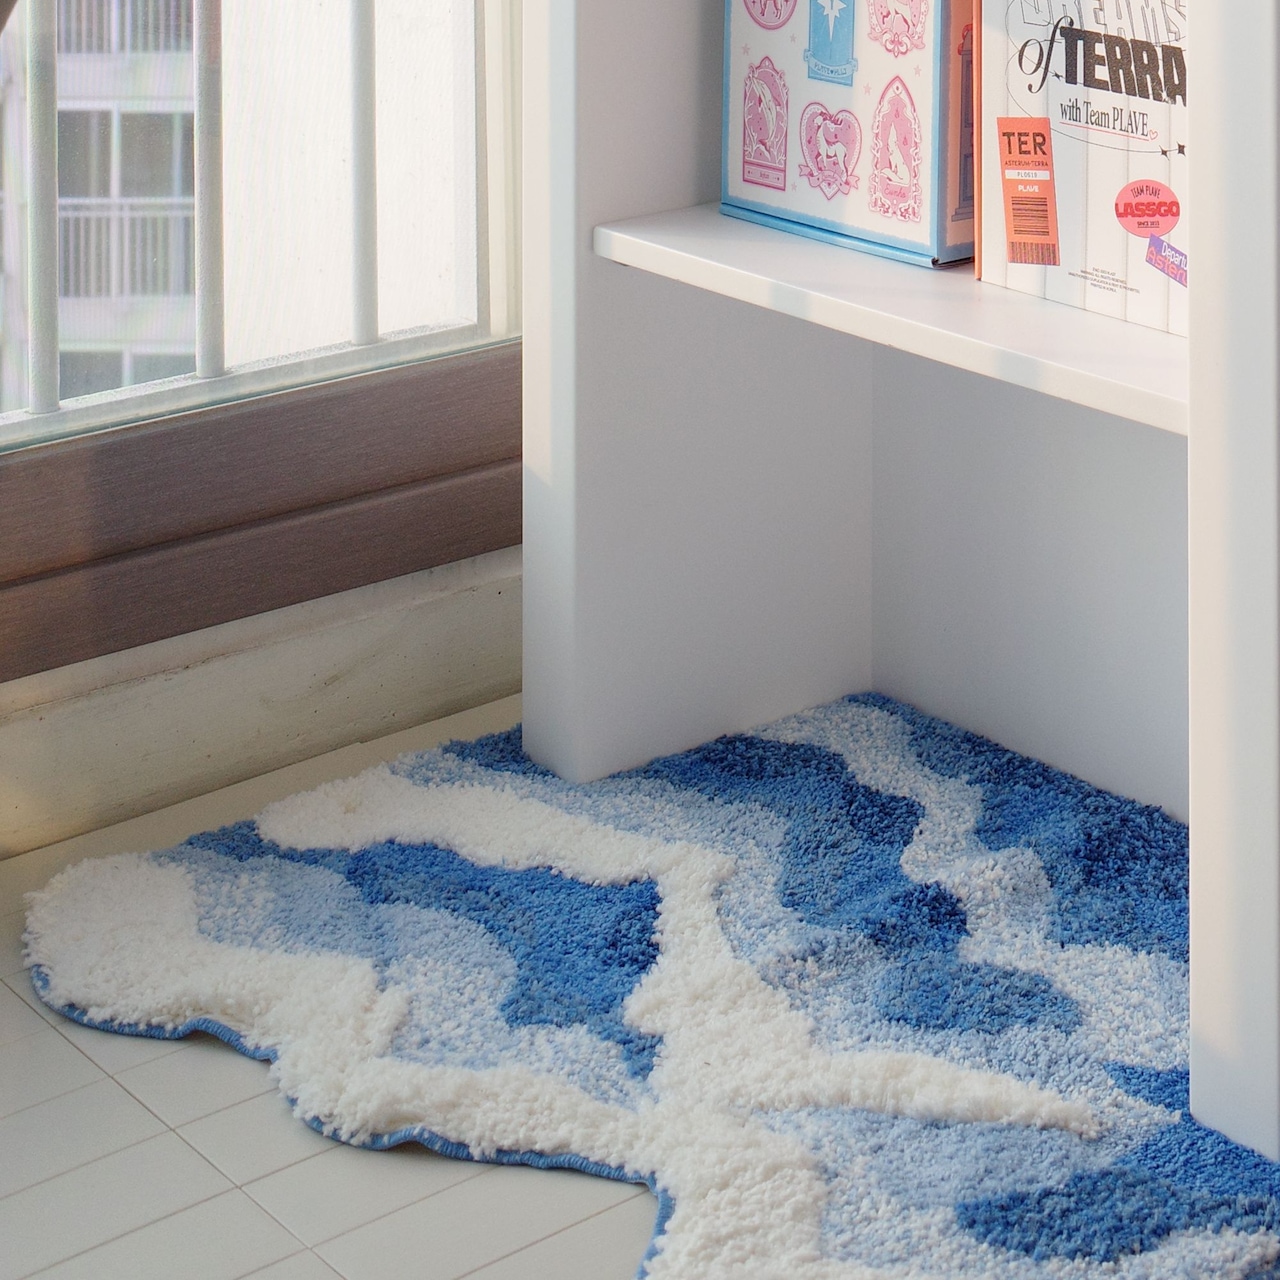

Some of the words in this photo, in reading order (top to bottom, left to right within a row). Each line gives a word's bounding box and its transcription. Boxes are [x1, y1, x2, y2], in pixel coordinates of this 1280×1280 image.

[1018, 15, 1075, 94] of
[1059, 26, 1187, 107] TERRA
[1060, 97, 1082, 123] with
[1083, 100, 1111, 129] Team
[1112, 106, 1149, 137] PLAVE
[1002, 131, 1048, 156] TER
